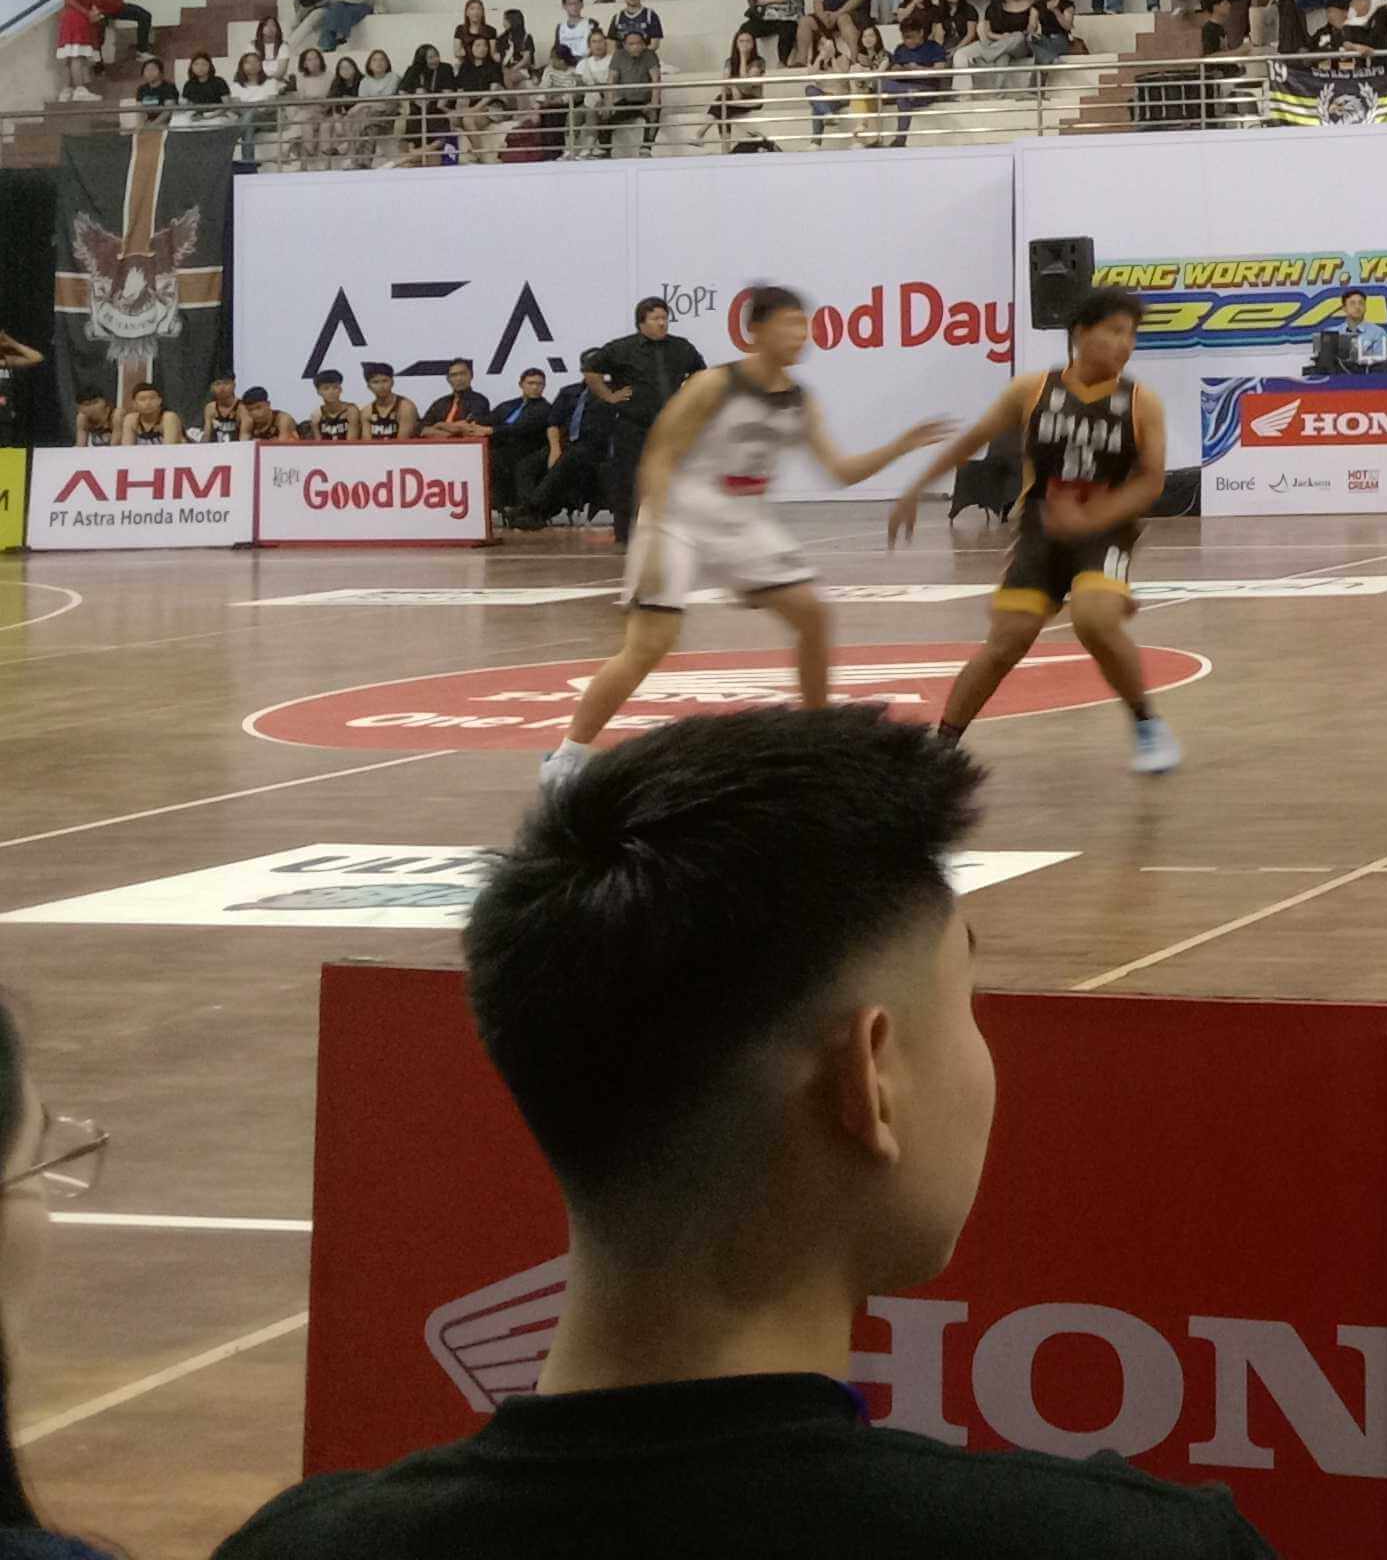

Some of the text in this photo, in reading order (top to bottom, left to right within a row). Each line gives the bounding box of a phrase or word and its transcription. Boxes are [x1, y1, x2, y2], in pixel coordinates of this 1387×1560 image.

[1091, 263, 1180, 289] YANG
[1183, 258, 1306, 288] WORTH
[899, 281, 1014, 364] Day
[53, 464, 233, 504] AHM
[1215, 475, 1256, 491] Bioré
[1292, 476, 1332, 488] Jackson
[1347, 480, 1379, 490] CREAM
[303, 468, 394, 510] Good
[399, 467, 469, 520] Day
[49, 507, 231, 528] PT Astra Honda Motor
[345, 712, 524, 730] One
